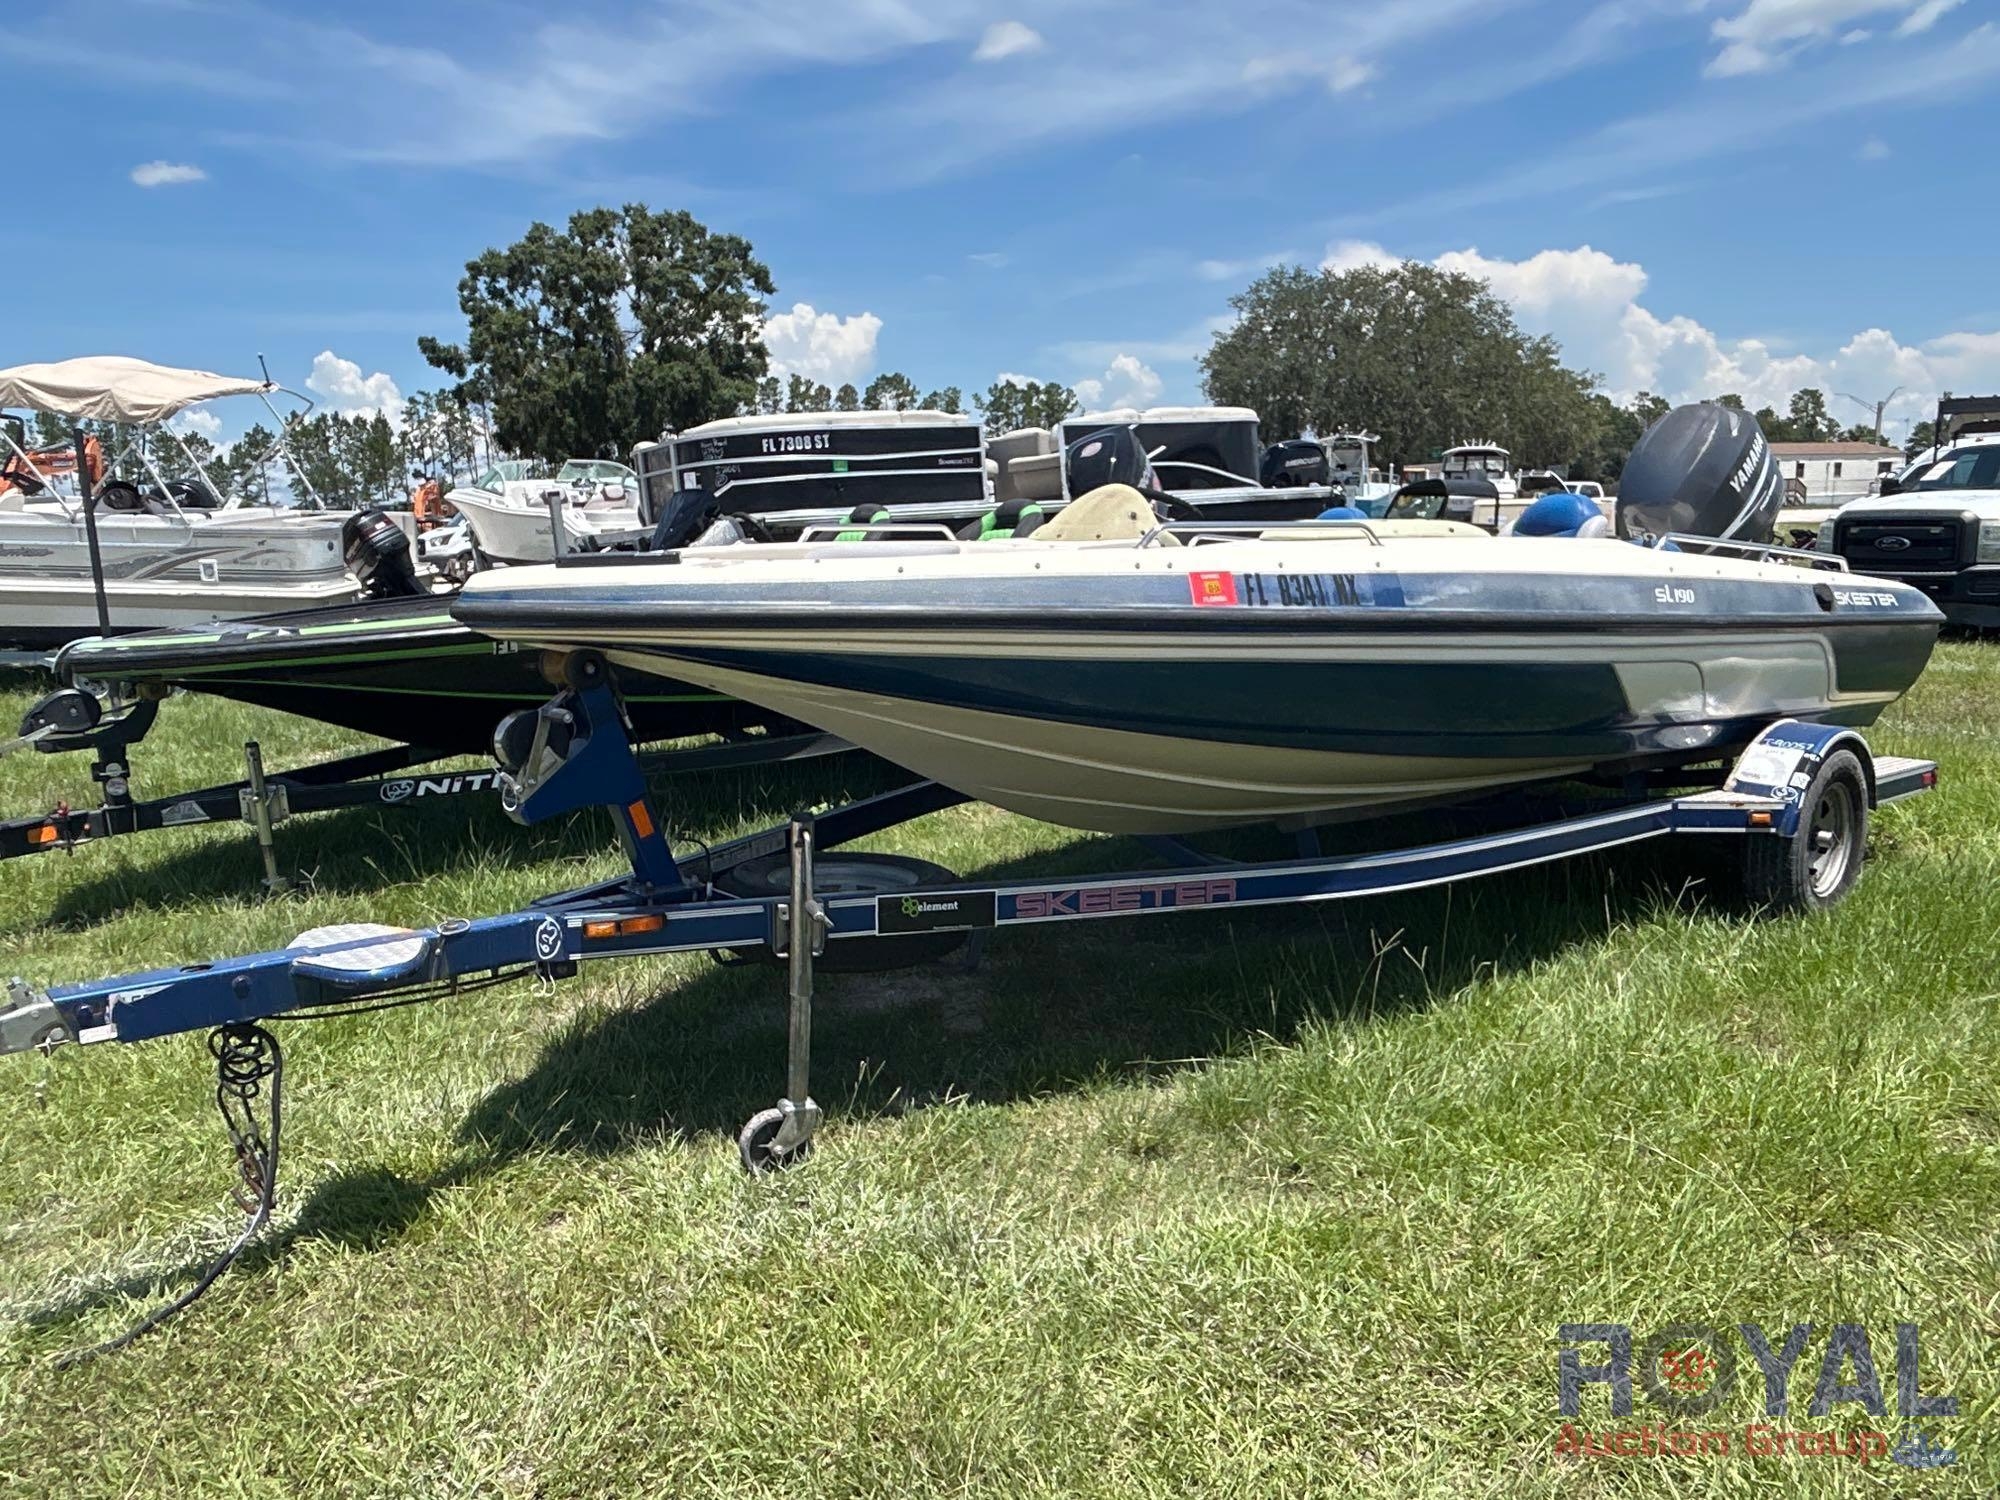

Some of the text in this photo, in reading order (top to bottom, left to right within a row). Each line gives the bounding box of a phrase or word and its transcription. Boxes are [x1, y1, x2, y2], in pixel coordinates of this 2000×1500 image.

[761, 438, 776, 452] FL
[814, 434, 830, 449] ST
[1729, 432, 1764, 493] YAMAHA
[1244, 573, 1268, 606] FL
[1834, 591, 1899, 607] SKEETER
[917, 901, 959, 912] element
[1015, 879, 1237, 918] SKEETER
